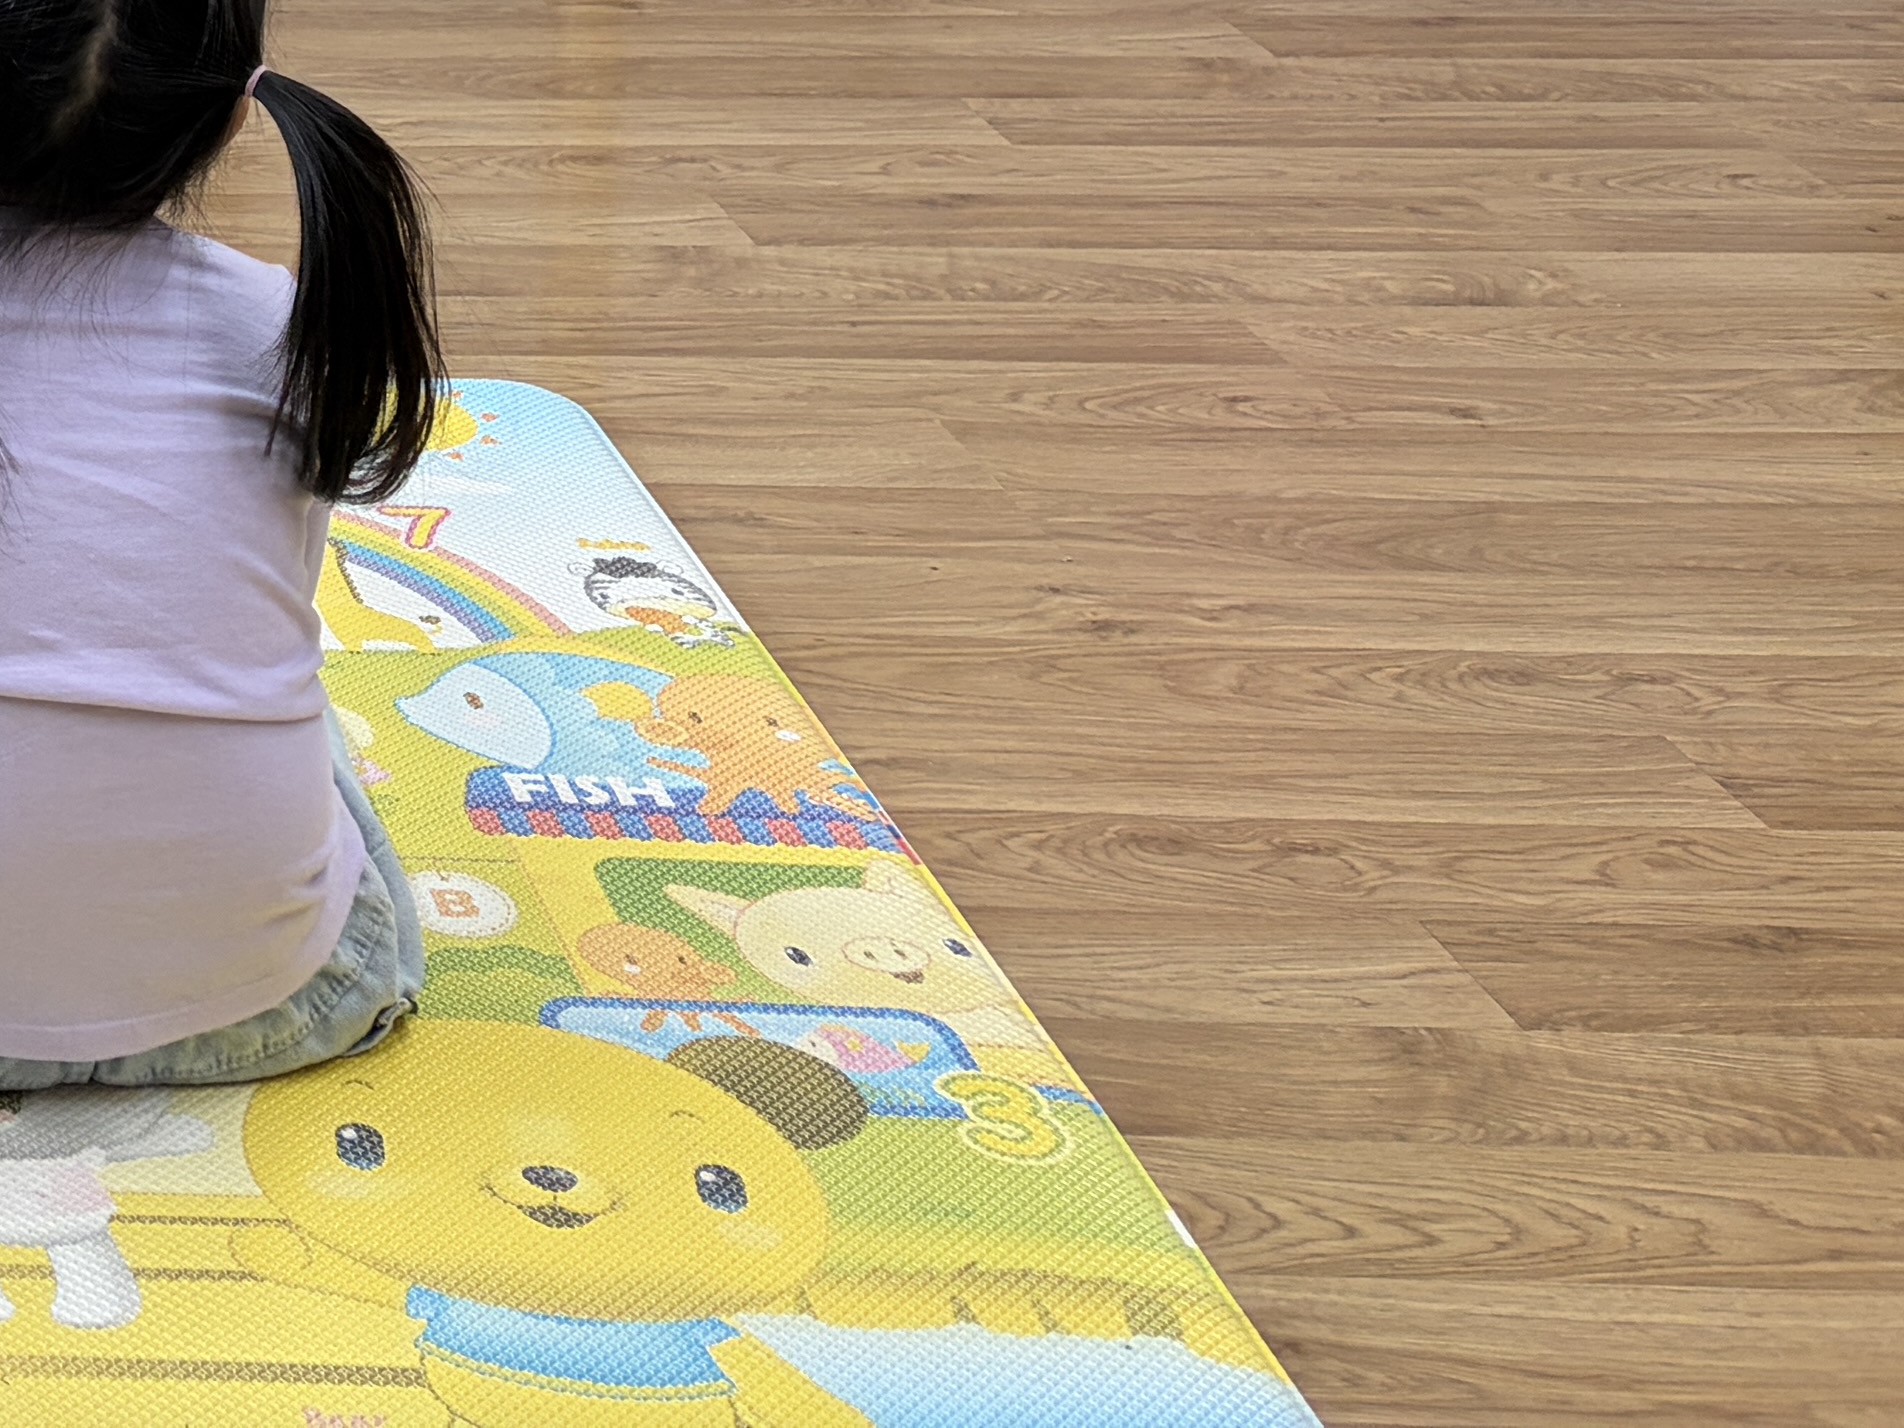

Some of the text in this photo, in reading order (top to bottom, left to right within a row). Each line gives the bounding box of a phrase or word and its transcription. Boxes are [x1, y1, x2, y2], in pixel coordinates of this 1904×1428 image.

[379, 505, 452, 550] 7
[503, 770, 677, 808] FISH
[432, 888, 481, 920] B
[936, 1073, 1076, 1165] 3
